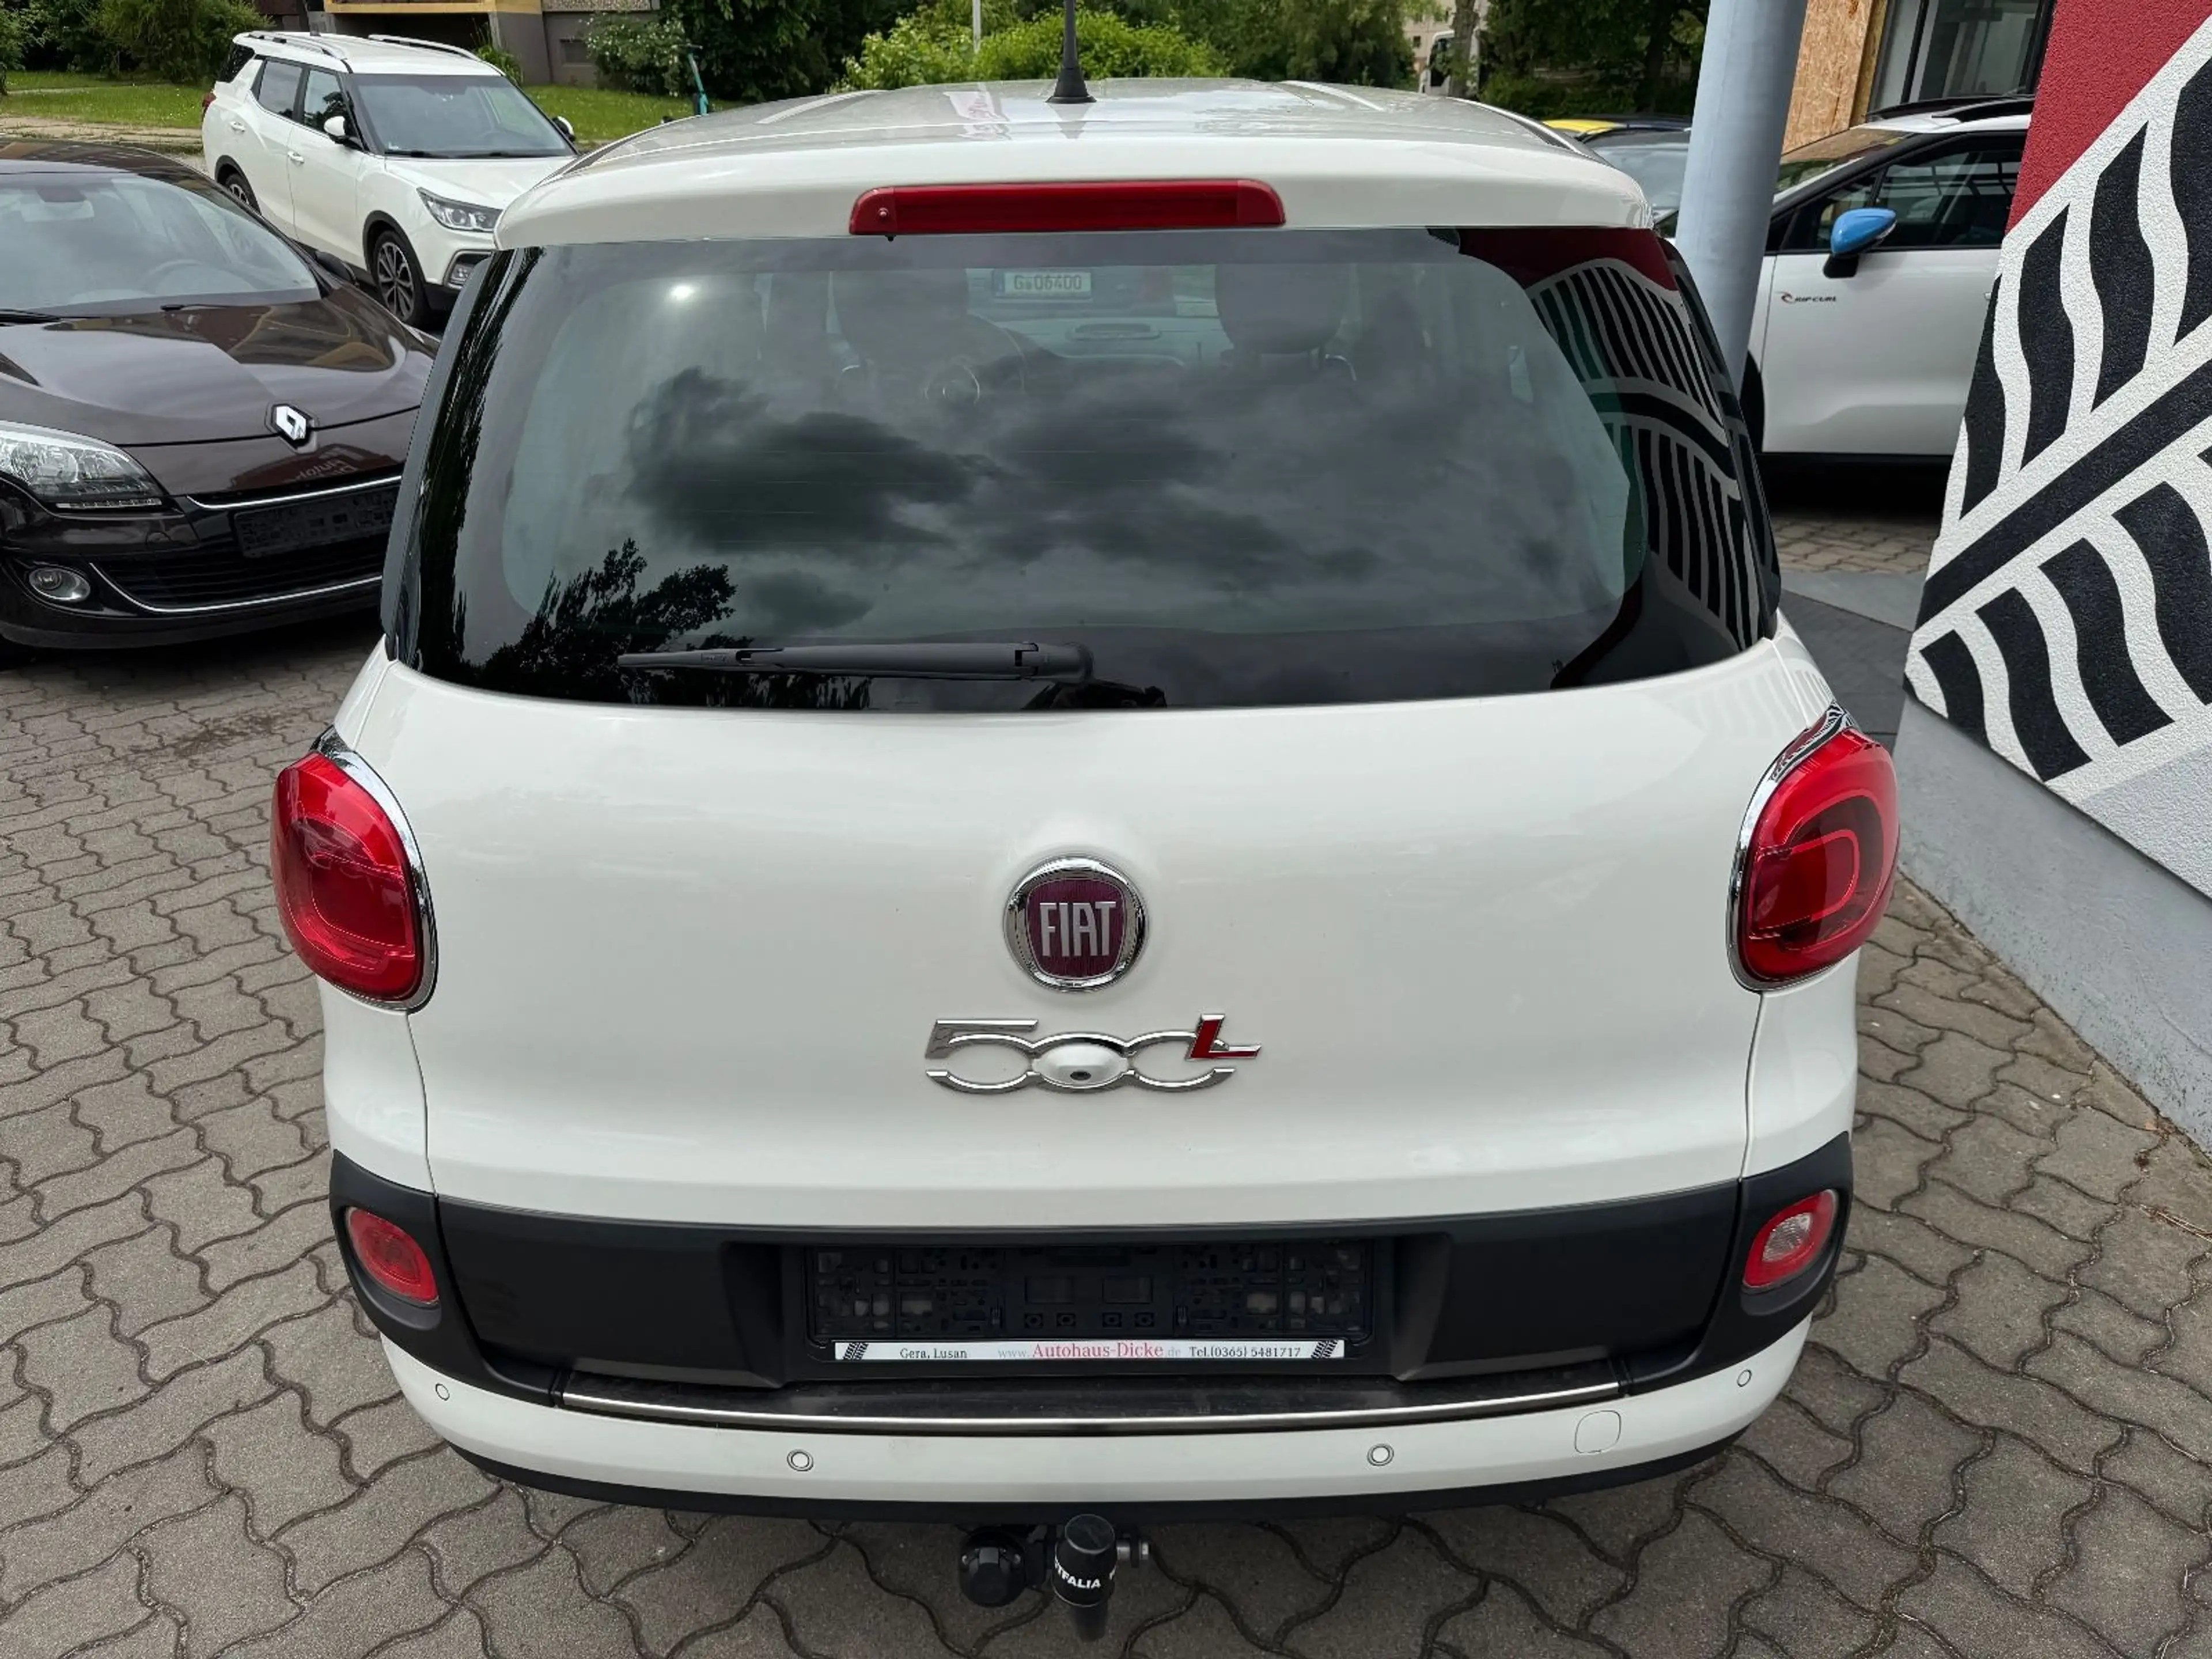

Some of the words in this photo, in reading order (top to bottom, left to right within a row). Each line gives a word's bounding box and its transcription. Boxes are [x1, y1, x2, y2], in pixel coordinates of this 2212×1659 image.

[1039, 901, 1116, 957] FIAT
[900, 1347, 930, 1359] Gera,
[933, 1347, 967, 1358] Lusan
